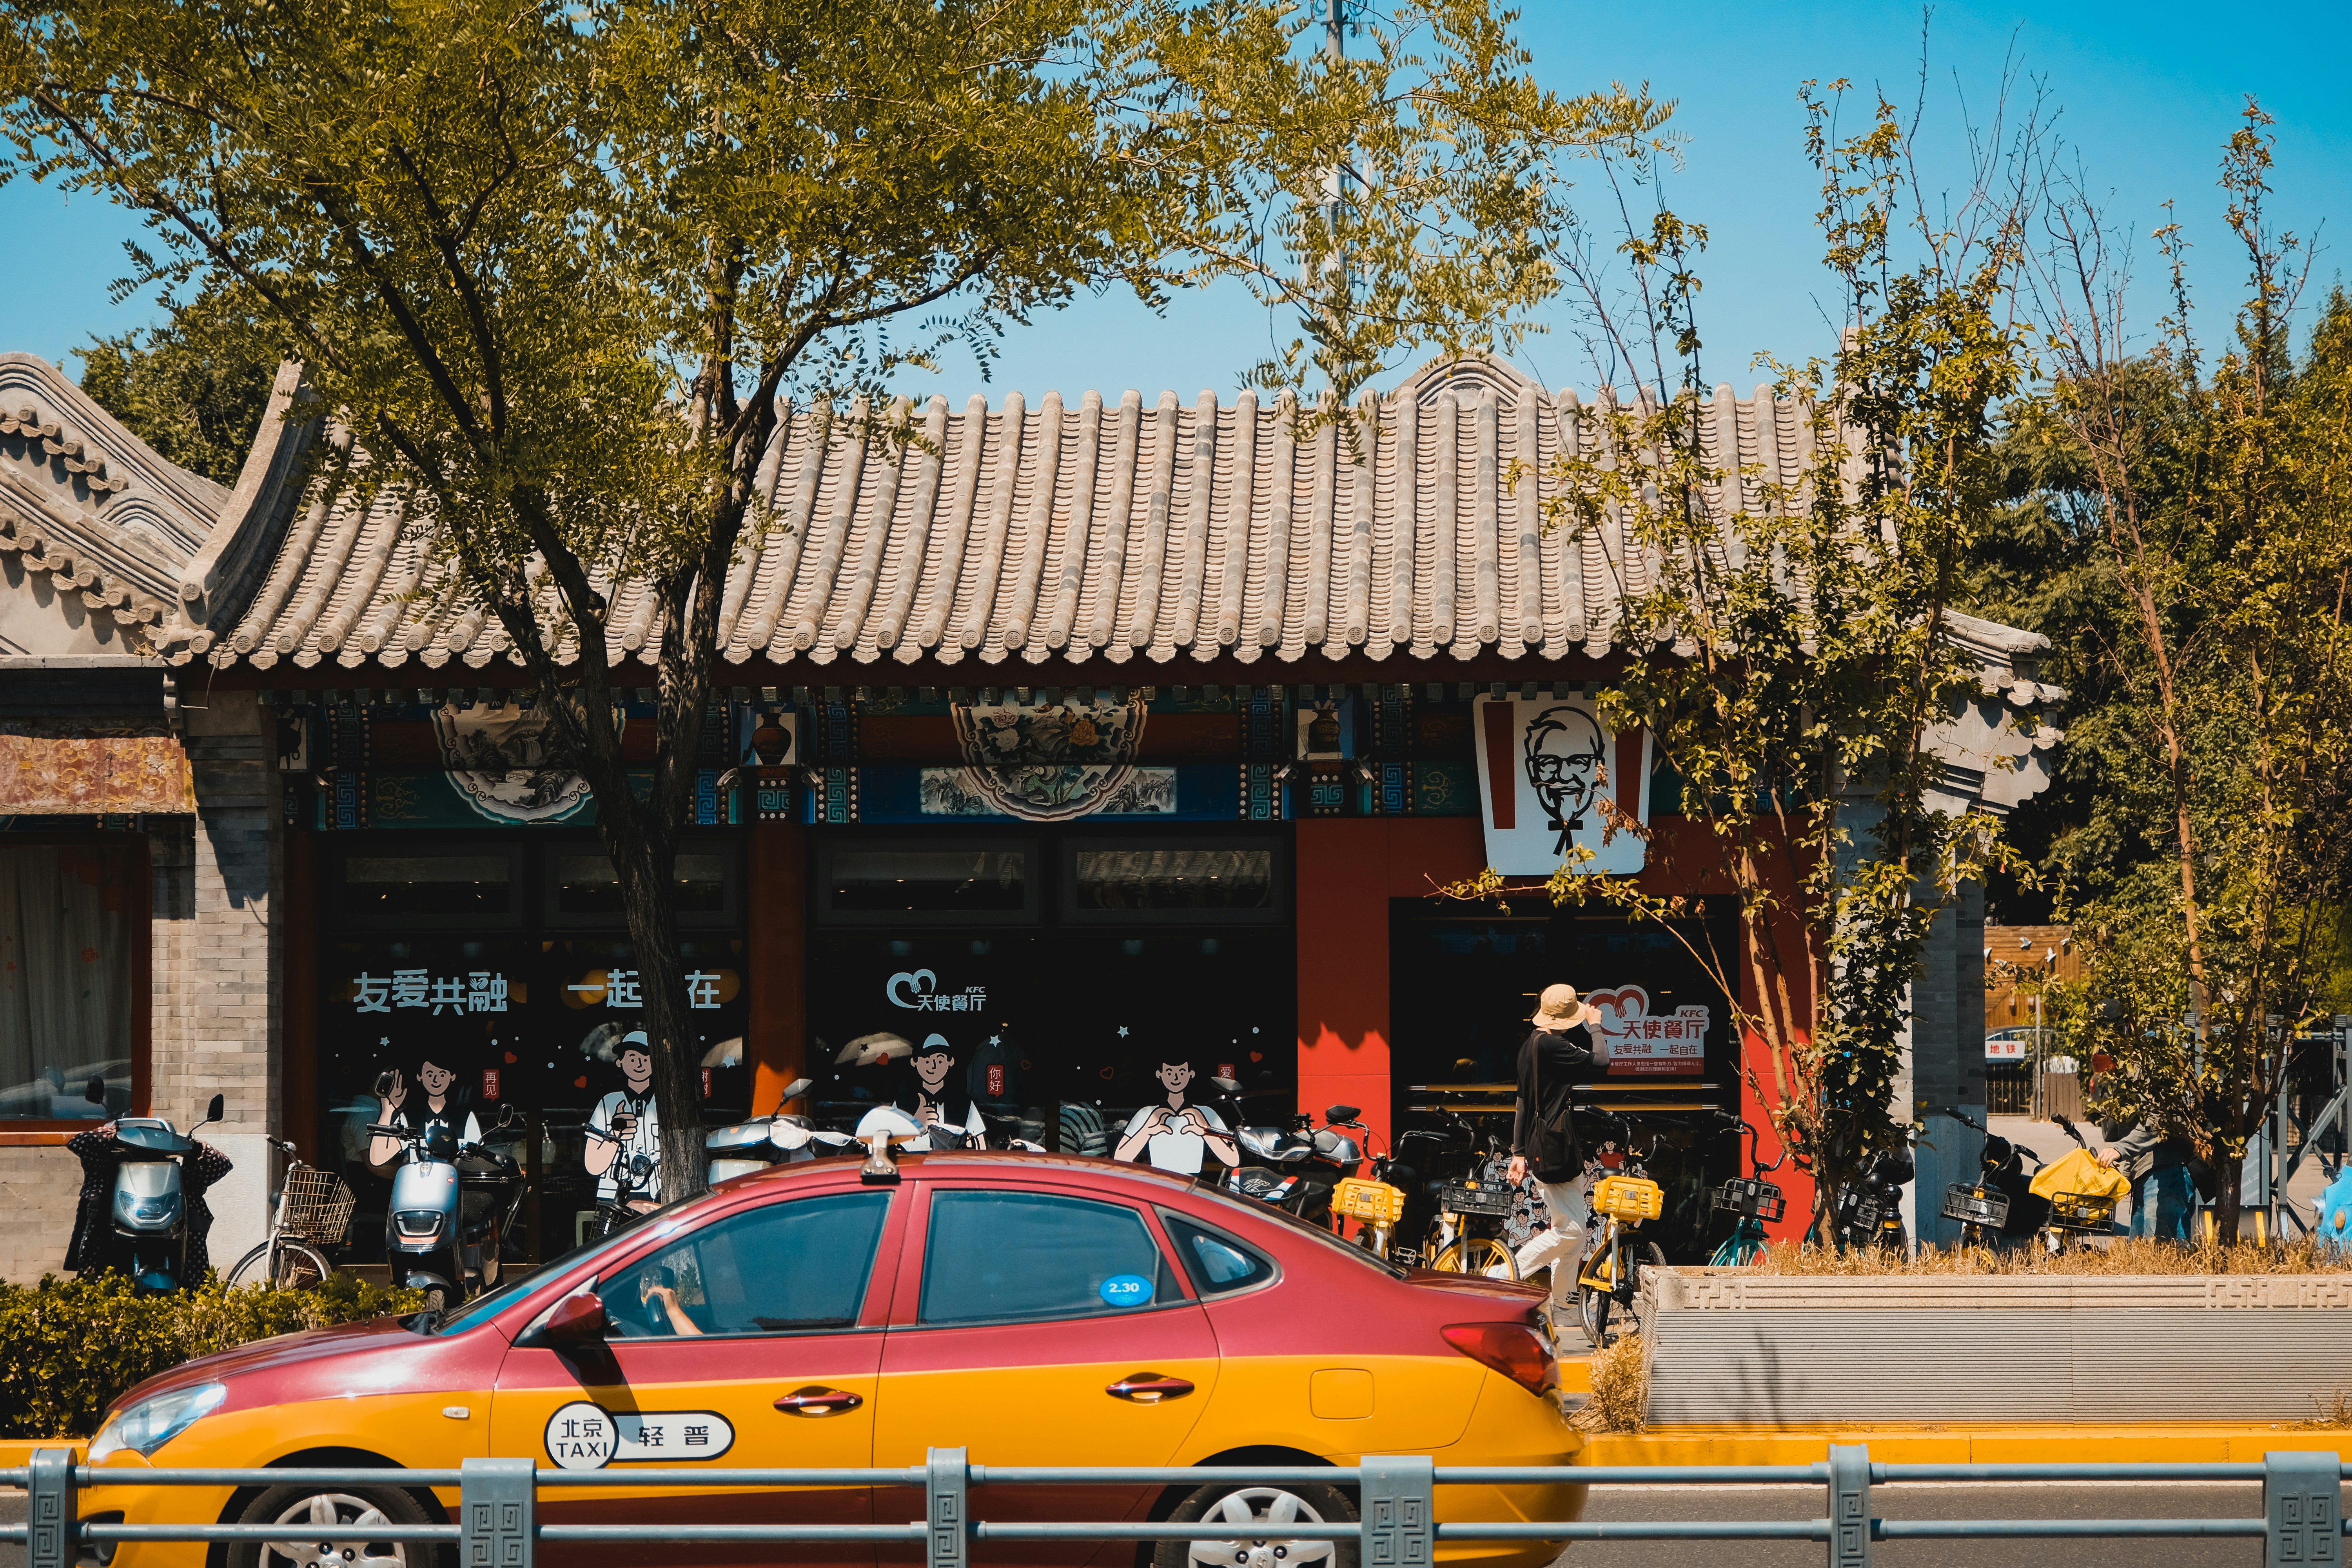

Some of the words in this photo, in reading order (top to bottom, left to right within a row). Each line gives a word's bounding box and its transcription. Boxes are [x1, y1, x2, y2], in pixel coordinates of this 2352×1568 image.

[354, 969, 507, 1015] 友爱共融
[568, 969, 720, 1009] 一起在
[918, 995, 986, 1011] 天使餐厅
[1623, 1020, 1705, 1039] 天使餐厅
[1614, 1044, 1651, 1055] 友爱共融
[1660, 1044, 1698, 1055] 一起自在
[1990, 1044, 2016, 1054] 地铁
[485, 1073, 497, 1095] 再见
[989, 1067, 1001, 1091] 你好
[1109, 1283, 1139, 1293] 2.30
[561, 1419, 603, 1438] 北京
[555, 1442, 607, 1457] TAXI
